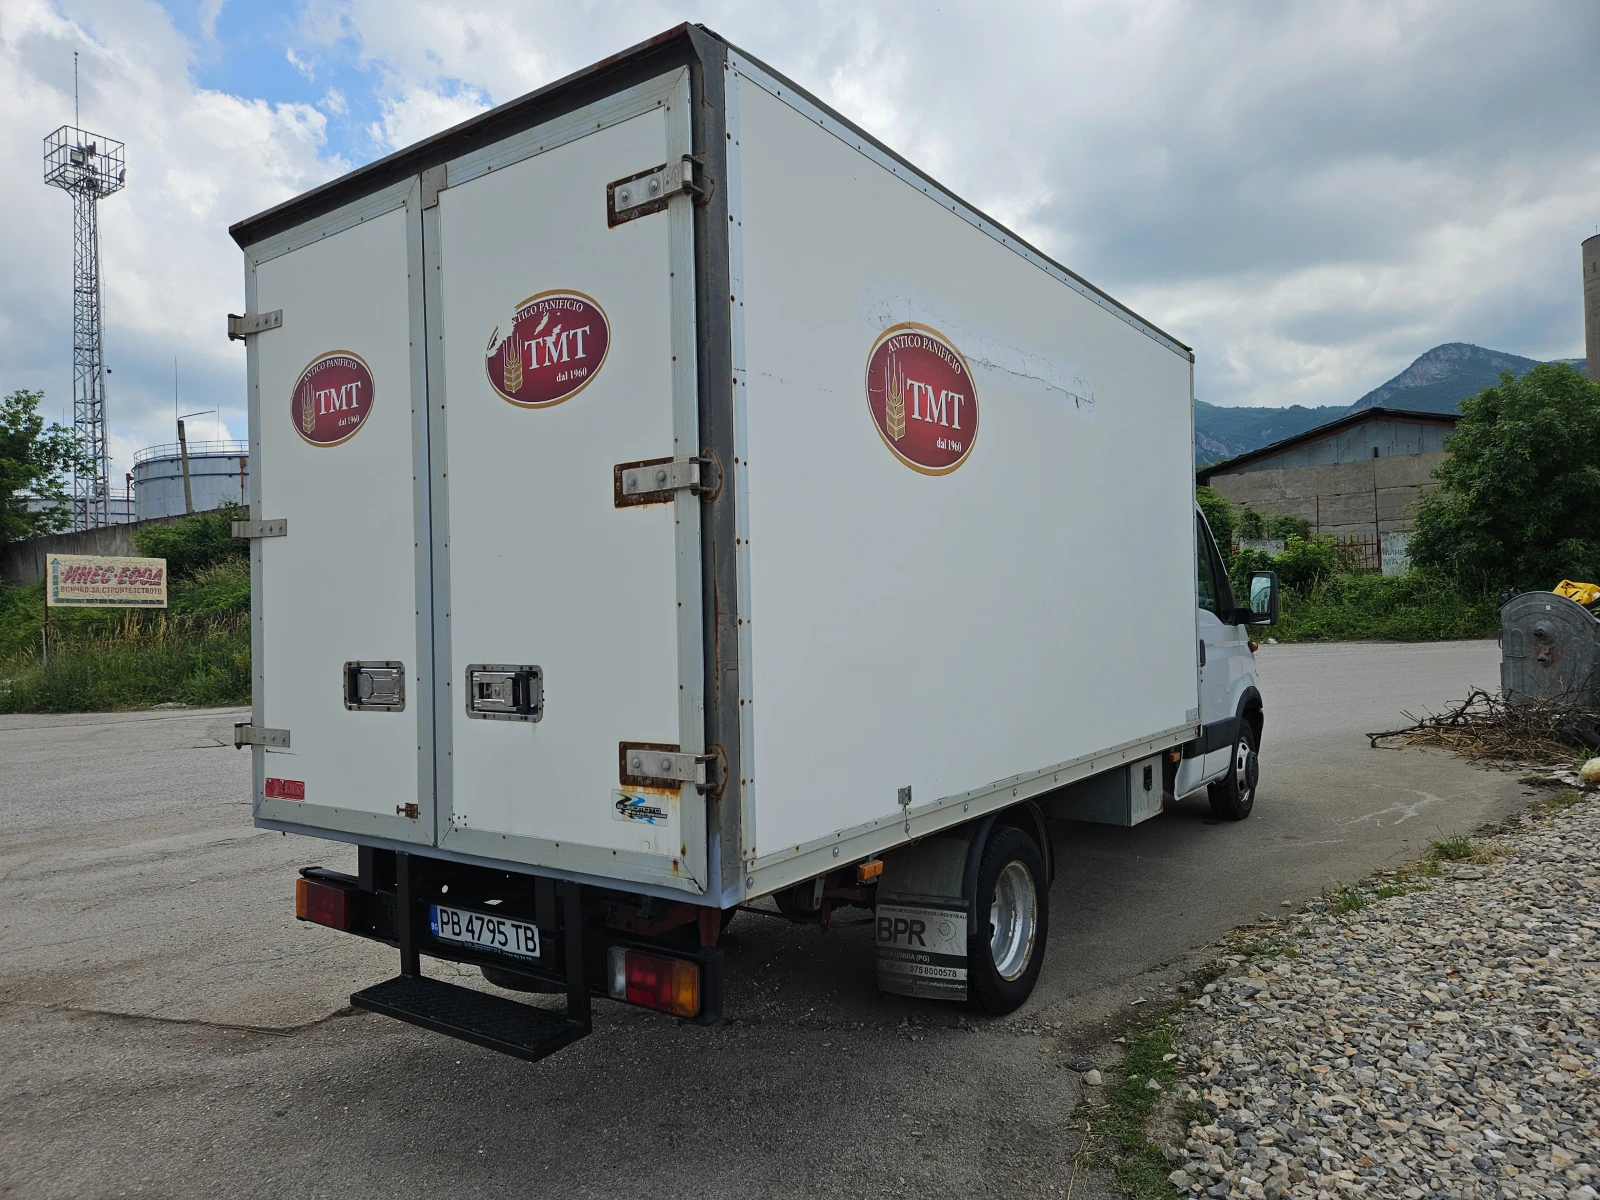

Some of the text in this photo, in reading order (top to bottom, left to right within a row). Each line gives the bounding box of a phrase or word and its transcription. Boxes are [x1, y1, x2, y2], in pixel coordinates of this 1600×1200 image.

[539, 299, 583, 312] PANIFICIO
[525, 325, 590, 369] TMT
[887, 335, 961, 374] ANTICO PANIFICIO
[304, 358, 357, 384] ANTICO PANIFICIO
[556, 366, 587, 382] dal 1960
[316, 381, 361, 415] TMT
[906, 377, 965, 430] TMT
[337, 414, 360, 427] dal 1960
[936, 437, 962, 453] dal 1960
[91, 586, 100, 594] ЗА
[431, 922, 438, 931] BG
[440, 908, 462, 937] PB
[465, 914, 509, 947] 4795
[510, 923, 537, 953] TB
[877, 916, 927, 948] BPR
[915, 954, 930, 964] (PG)
[909, 965, 924, 974] 075
[924, 966, 957, 978] 8000578
